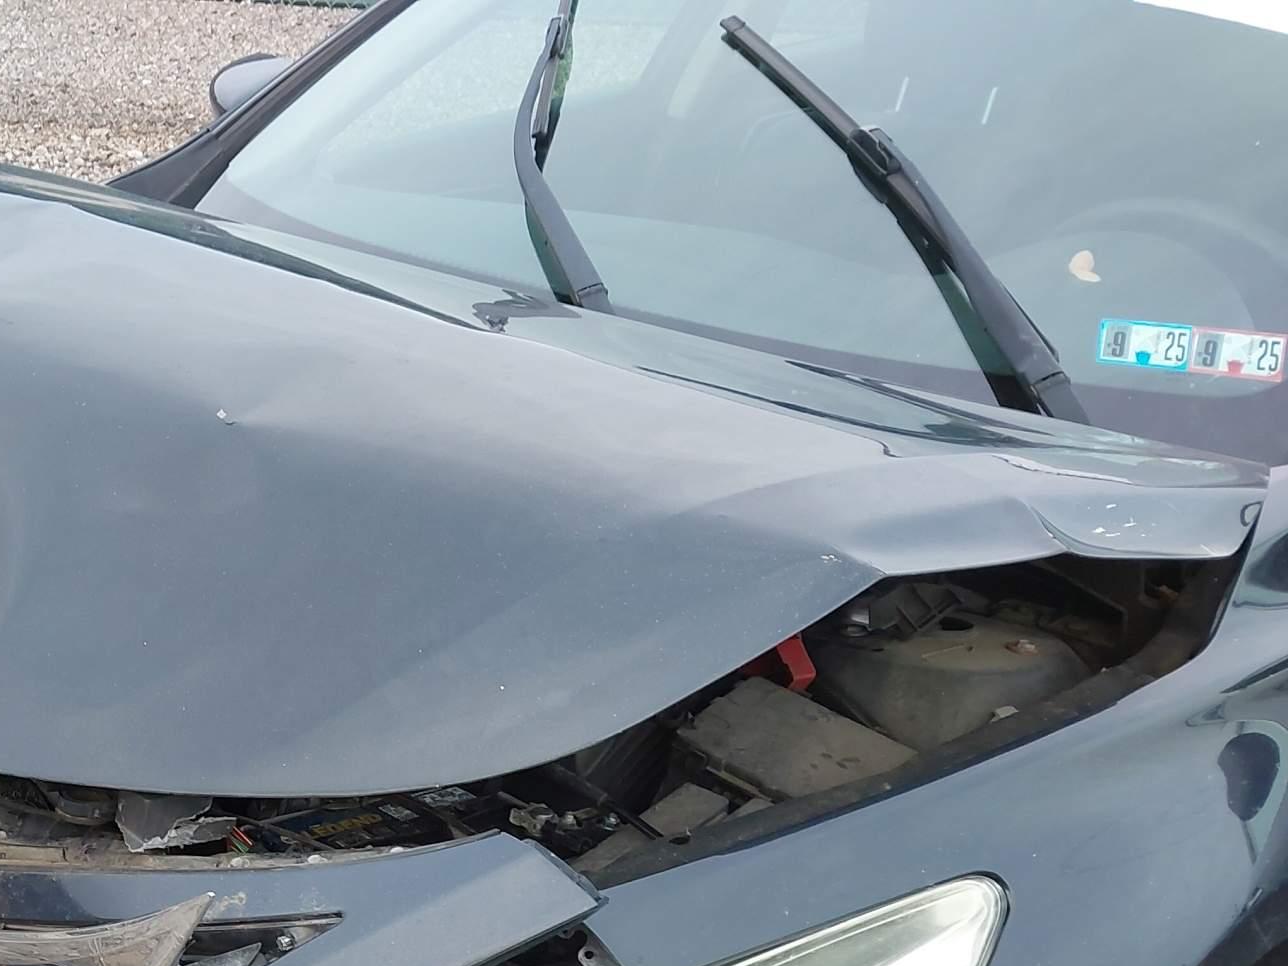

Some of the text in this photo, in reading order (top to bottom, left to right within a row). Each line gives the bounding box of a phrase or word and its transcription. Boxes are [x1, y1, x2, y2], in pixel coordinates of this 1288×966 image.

[1112, 331, 1127, 357] 9
[1165, 331, 1187, 362] 25
[1202, 339, 1218, 367] 9
[1256, 339, 1281, 372] 25
